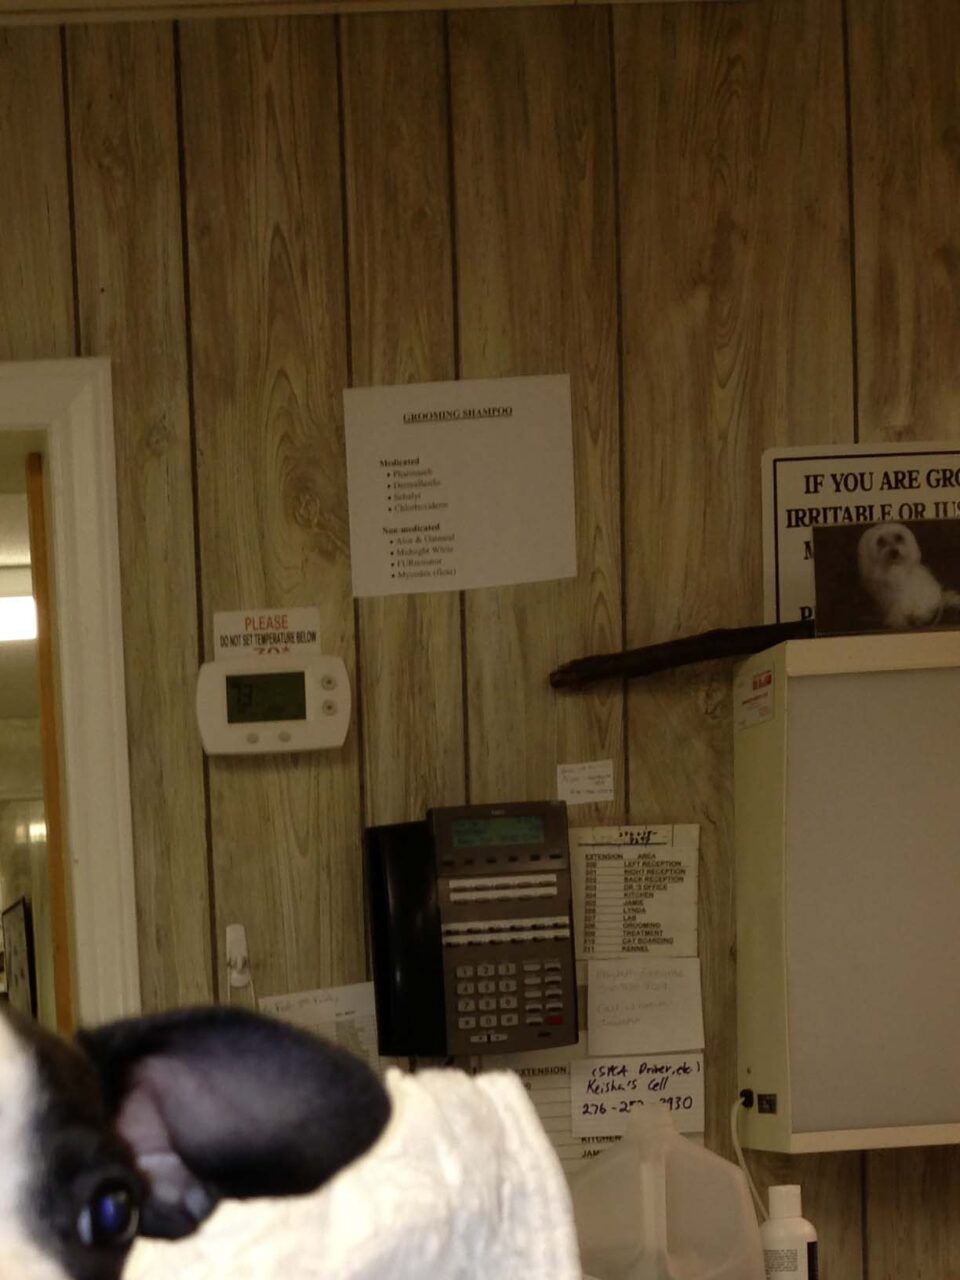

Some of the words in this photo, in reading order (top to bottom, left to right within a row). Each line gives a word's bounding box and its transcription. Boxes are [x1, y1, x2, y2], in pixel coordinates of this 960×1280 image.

[402, 409, 461, 423] GROOMING
[462, 406, 513, 420] SHAMPOO
[380, 456, 420, 468] Medicated
[804, 474, 825, 494] IF
[830, 472, 874, 493] YOU
[880, 470, 921, 491] ARE
[244, 614, 288, 631] PLEASE
[220, 635, 229, 648] DO
[230, 634, 241, 648] NOT
[242, 633, 253, 646] SET
[254, 632, 295, 646] TEMPERATURE
[296, 630, 317, 643] BELOW
[647, 1076, 670, 1091] Cell
[582, 1148, 603, 1159] JAM
